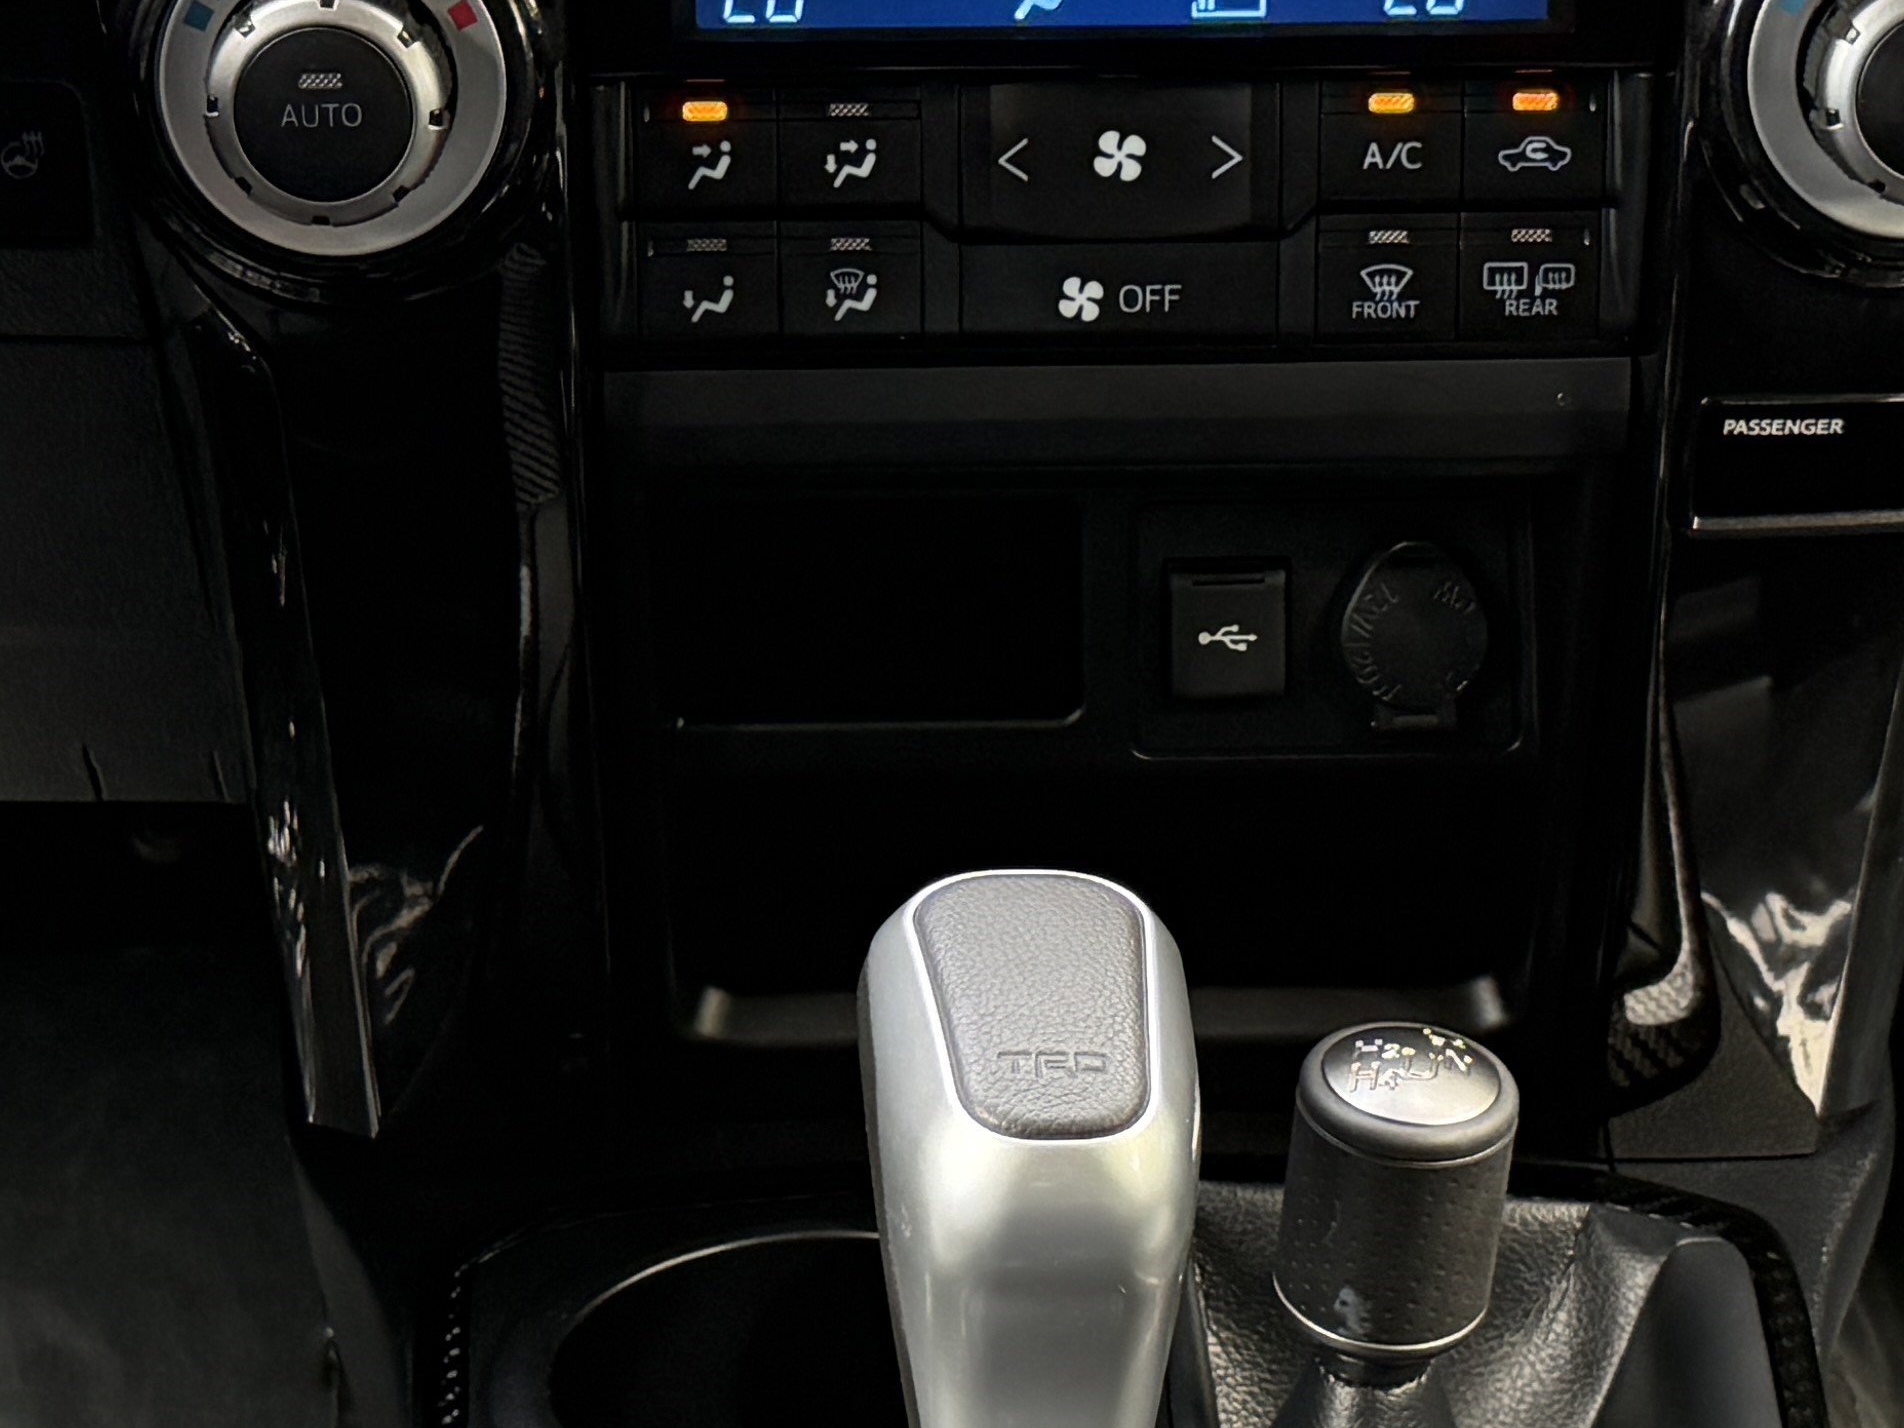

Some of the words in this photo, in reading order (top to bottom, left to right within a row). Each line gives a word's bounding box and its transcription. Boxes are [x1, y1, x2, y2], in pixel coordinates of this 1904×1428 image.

[280, 102, 363, 129] AUTO
[1362, 141, 1423, 171] A/C
[1117, 284, 1184, 315] OFF
[1351, 299, 1421, 321] FRONT
[1504, 297, 1559, 319] REAR
[1722, 418, 1846, 436] PASSENGER
